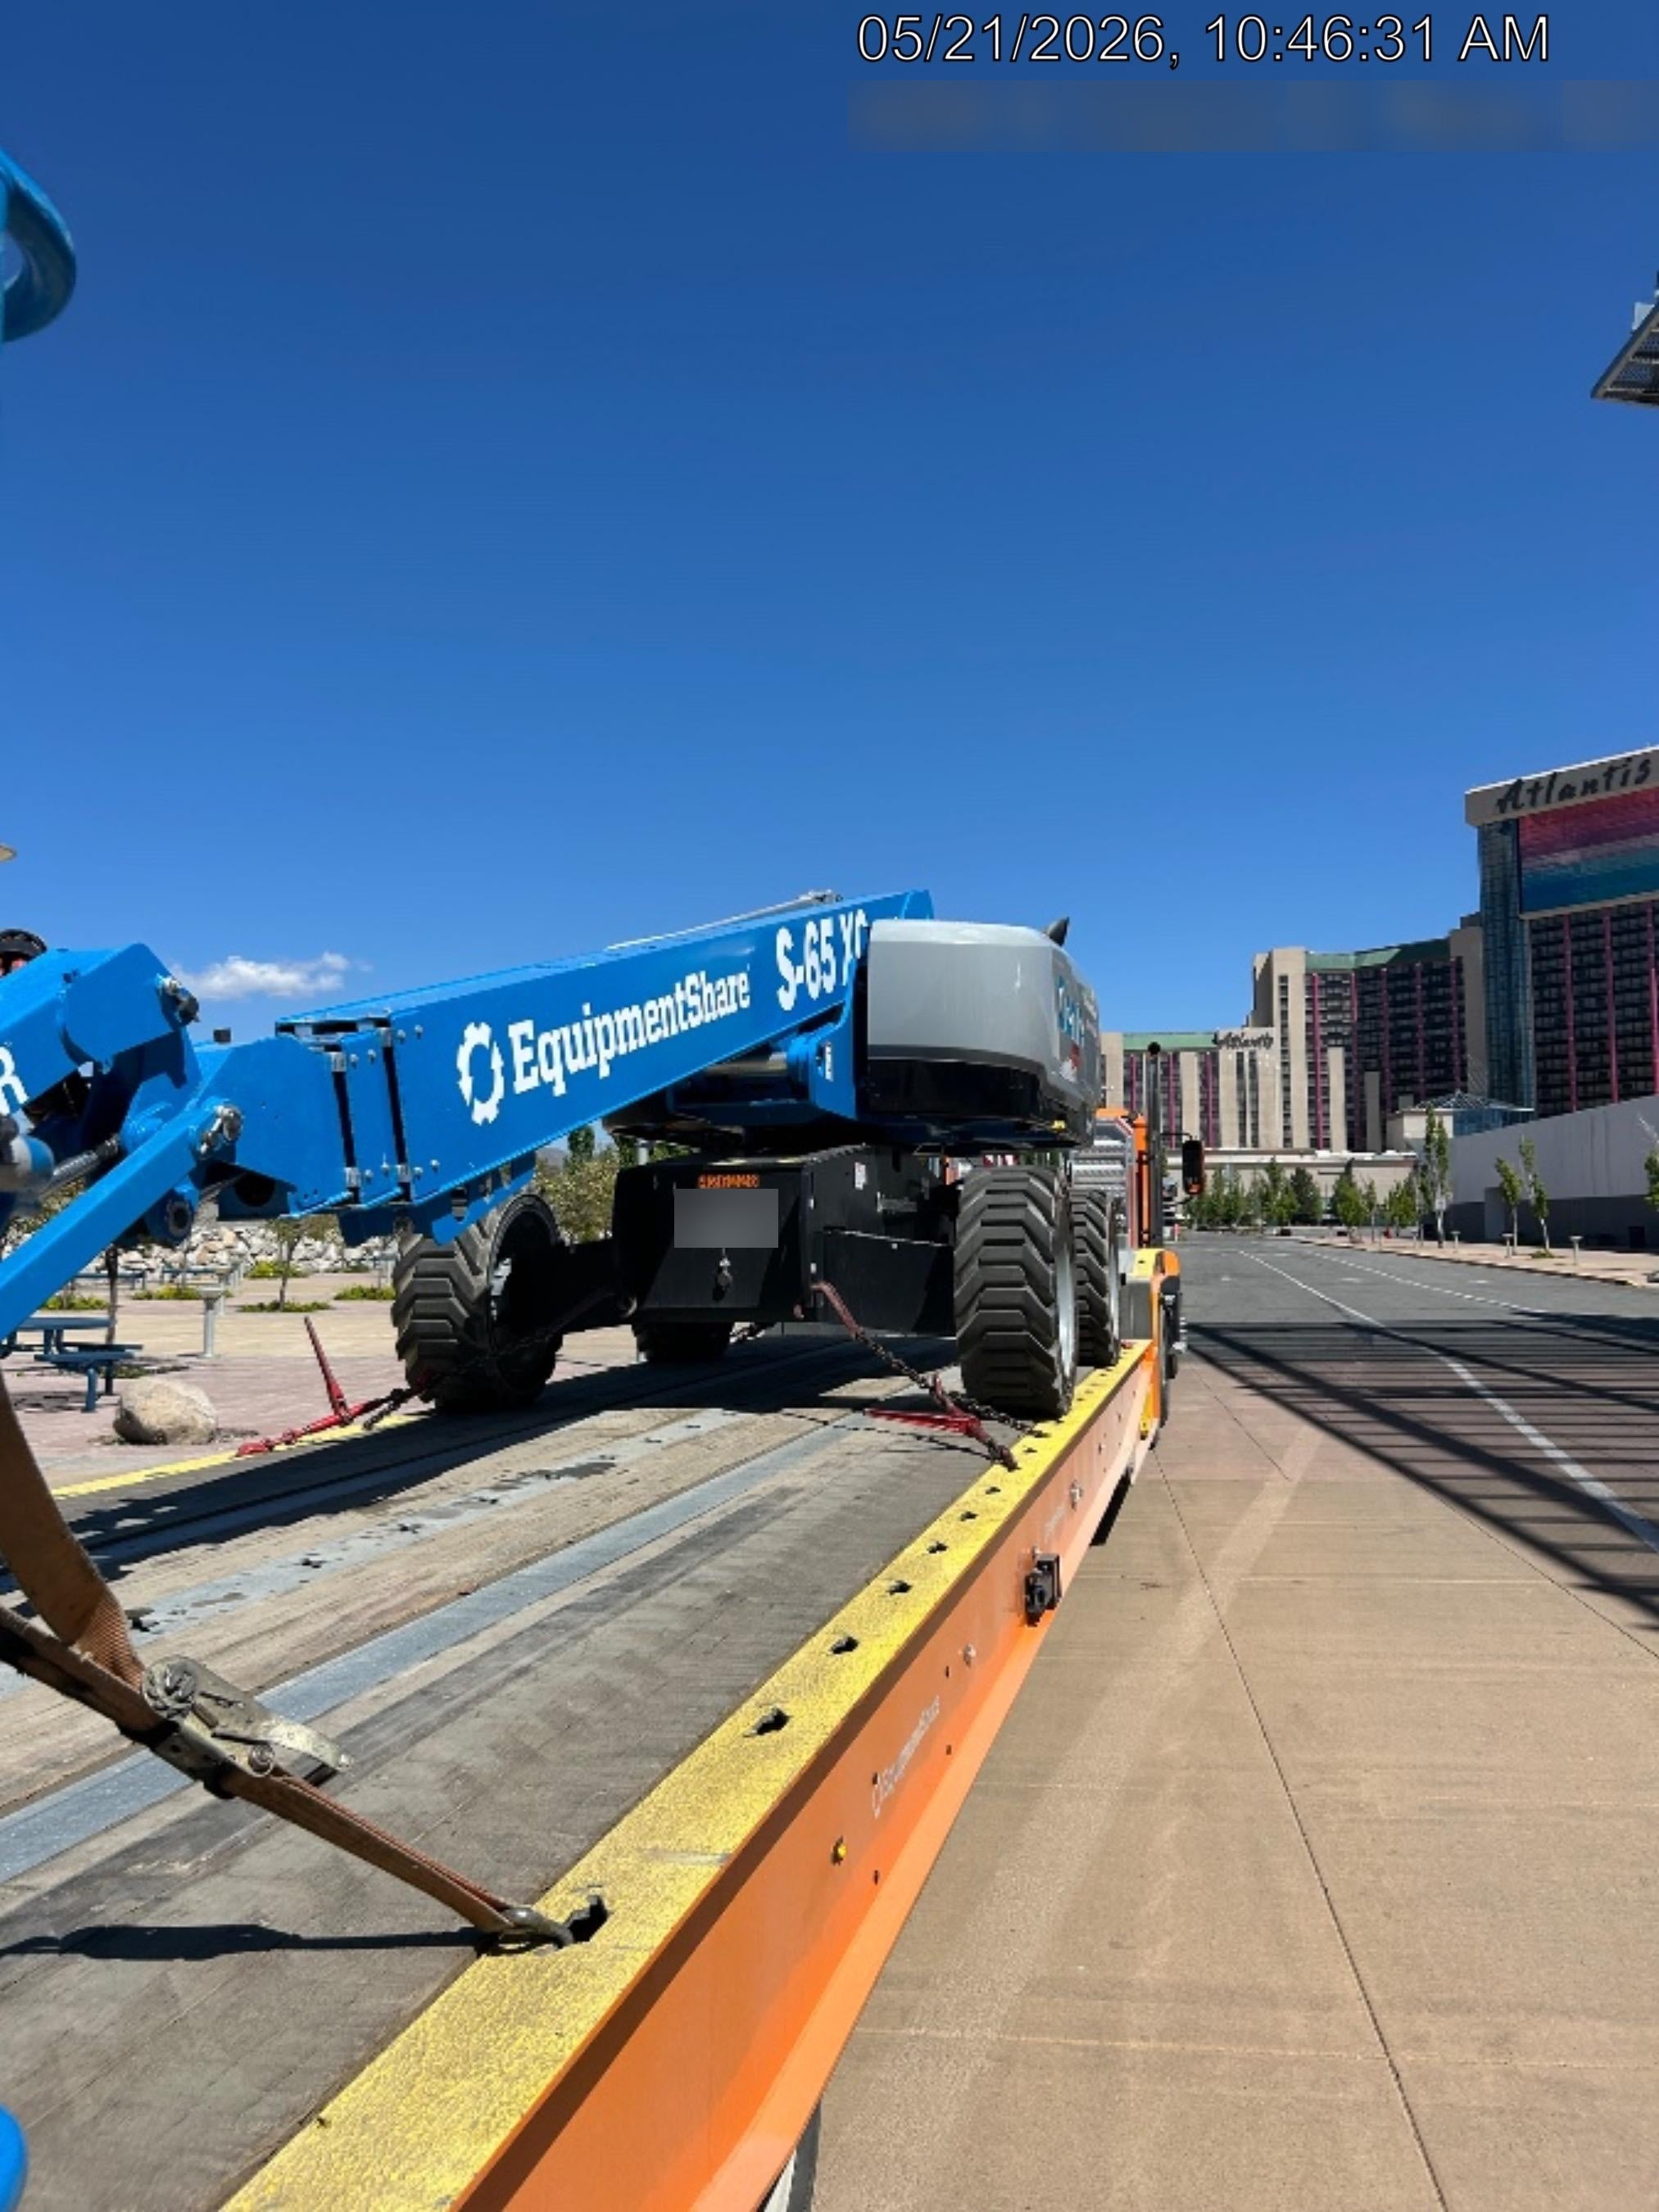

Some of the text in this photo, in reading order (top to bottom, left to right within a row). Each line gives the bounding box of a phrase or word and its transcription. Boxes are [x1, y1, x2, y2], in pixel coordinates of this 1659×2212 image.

[1496, 758, 1651, 814] Atlantis
[507, 970, 751, 1096] EquipmentShare
[776, 917, 836, 1011] S-65
